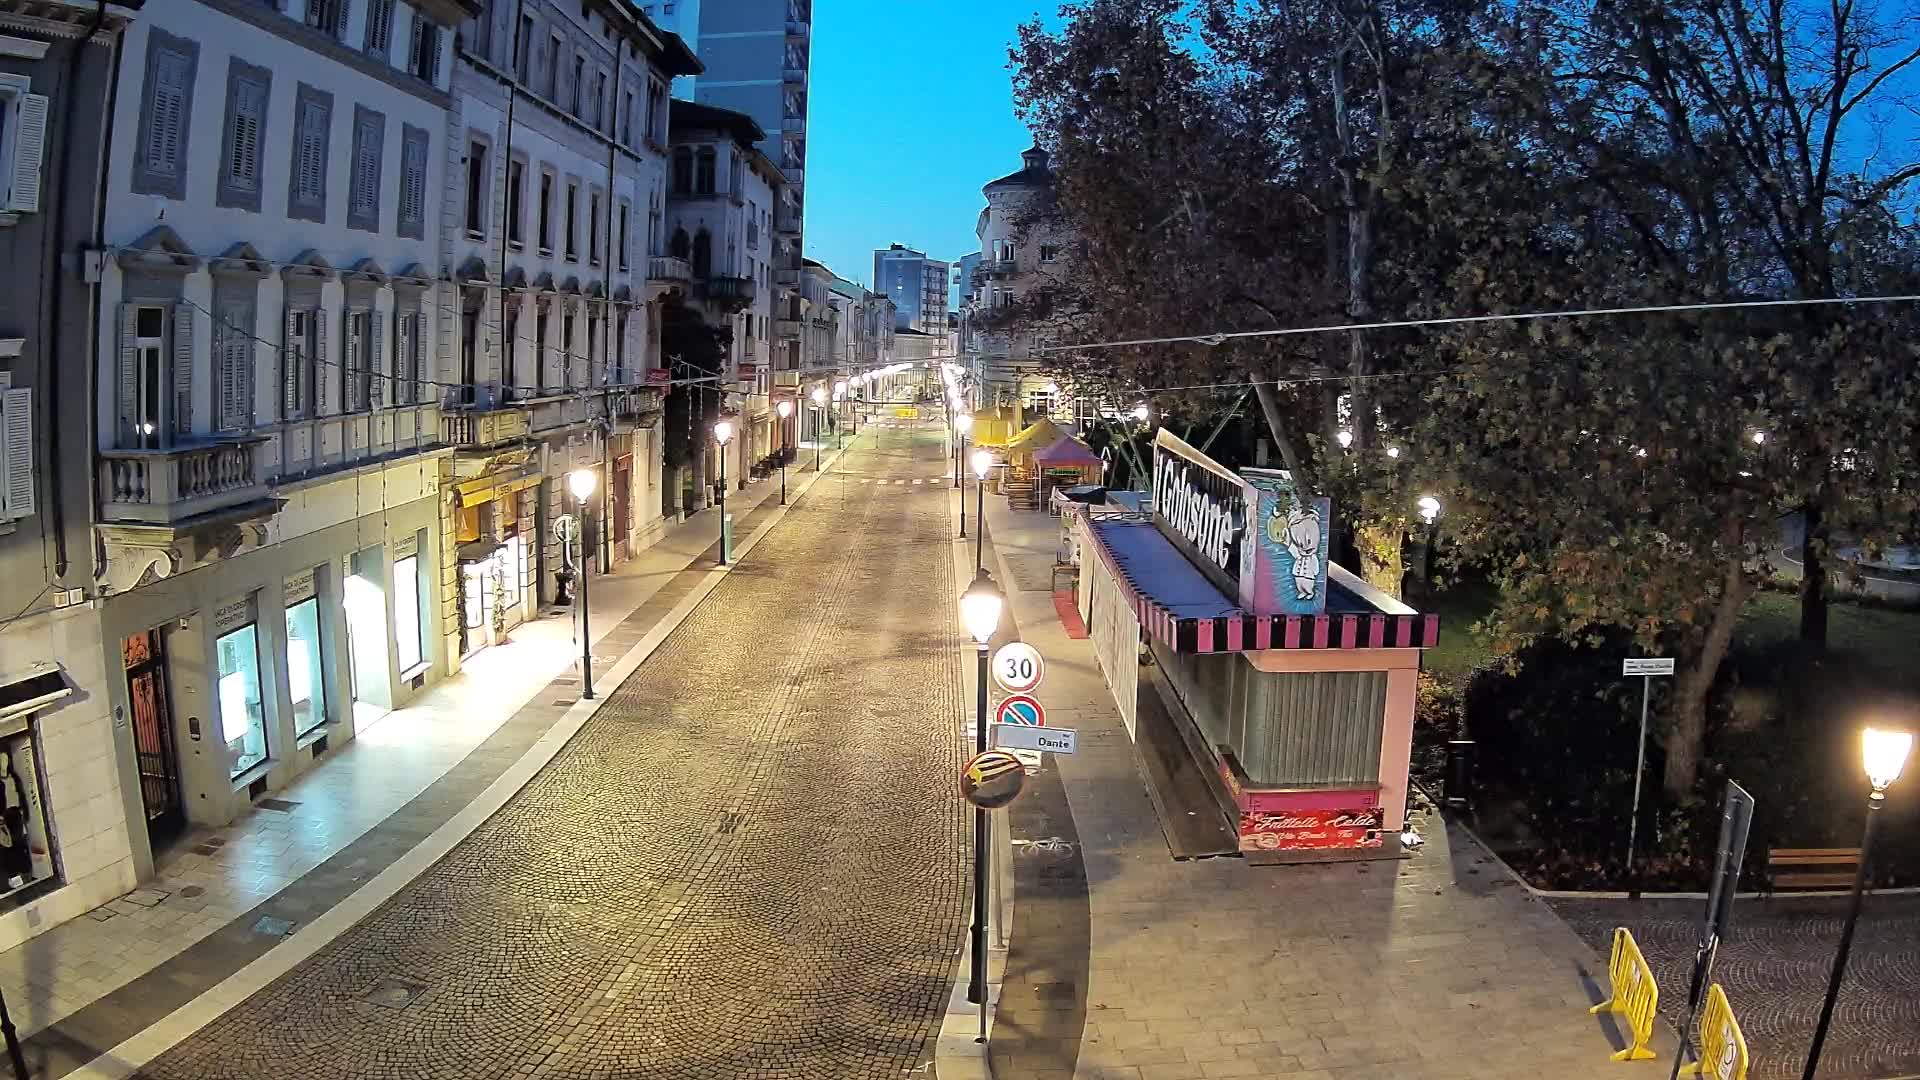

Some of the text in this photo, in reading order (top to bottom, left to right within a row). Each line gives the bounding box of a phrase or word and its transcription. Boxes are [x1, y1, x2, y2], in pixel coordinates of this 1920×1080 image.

[1153, 453, 1233, 569] Il Golosone
[1006, 659, 1032, 679] 30
[1038, 737, 1070, 749] Dante
